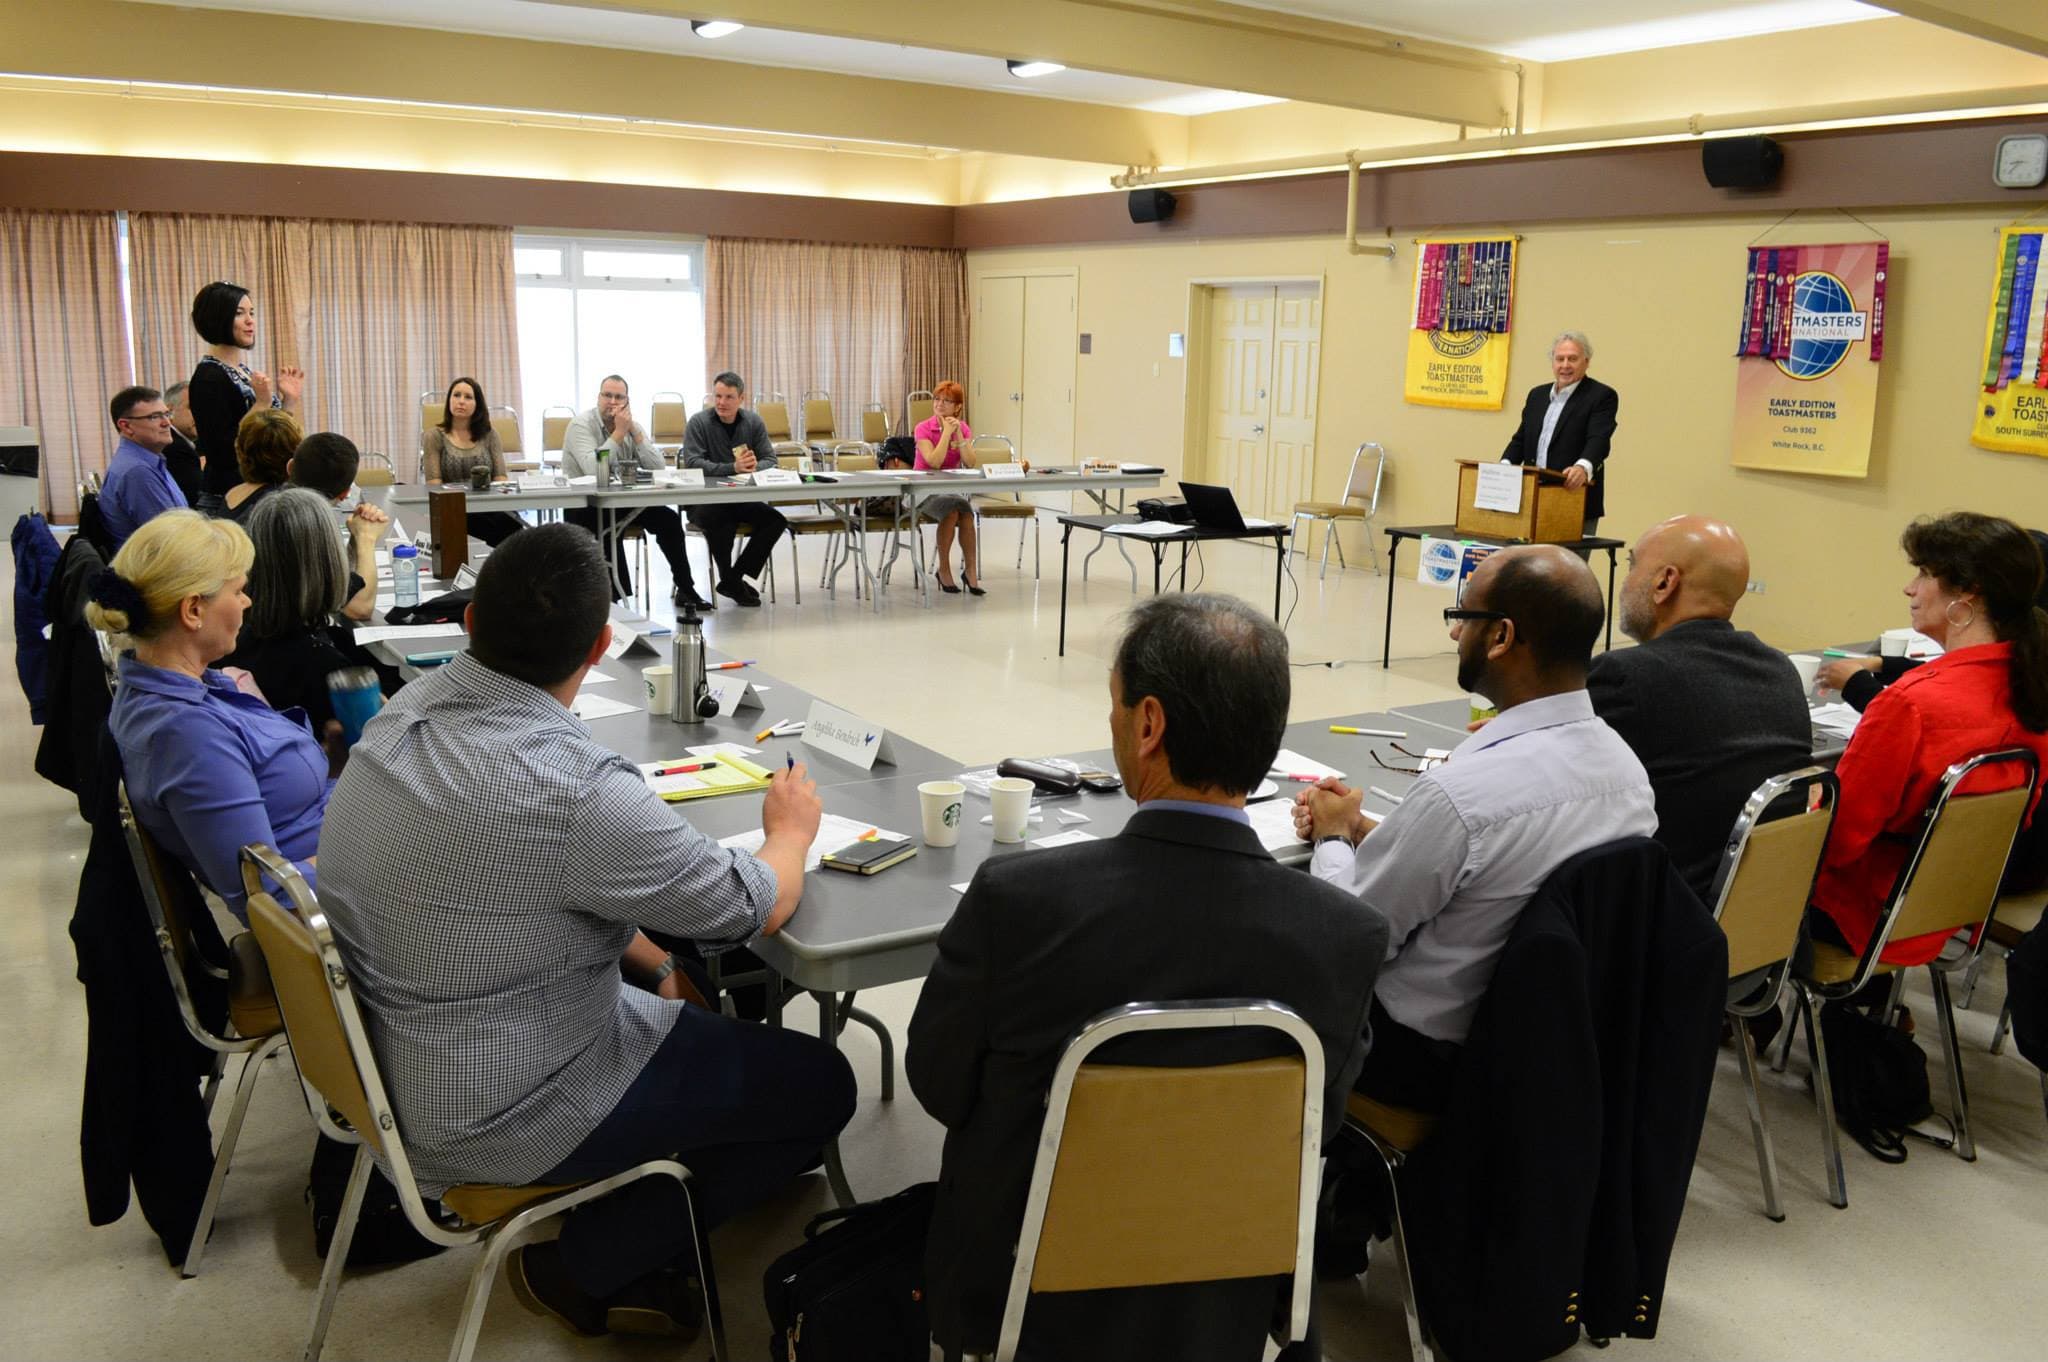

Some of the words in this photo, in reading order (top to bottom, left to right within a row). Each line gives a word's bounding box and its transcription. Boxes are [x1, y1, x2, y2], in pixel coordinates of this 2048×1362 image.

[1794, 316, 1862, 327] TMASTERS
[1428, 362, 1451, 373] EARLY
[1453, 364, 1482, 374] EDITION
[1427, 371, 1483, 383] TOASTMASTERS
[1770, 398, 1797, 408] EARLY
[1799, 400, 1836, 409] EDITION
[2017, 396, 2047, 409] EARL
[1768, 408, 1837, 419] TOASTMASTERS
[2012, 408, 2048, 422] TOAST
[1996, 426, 2021, 435] SOUTH
[1772, 440, 1791, 449] White
